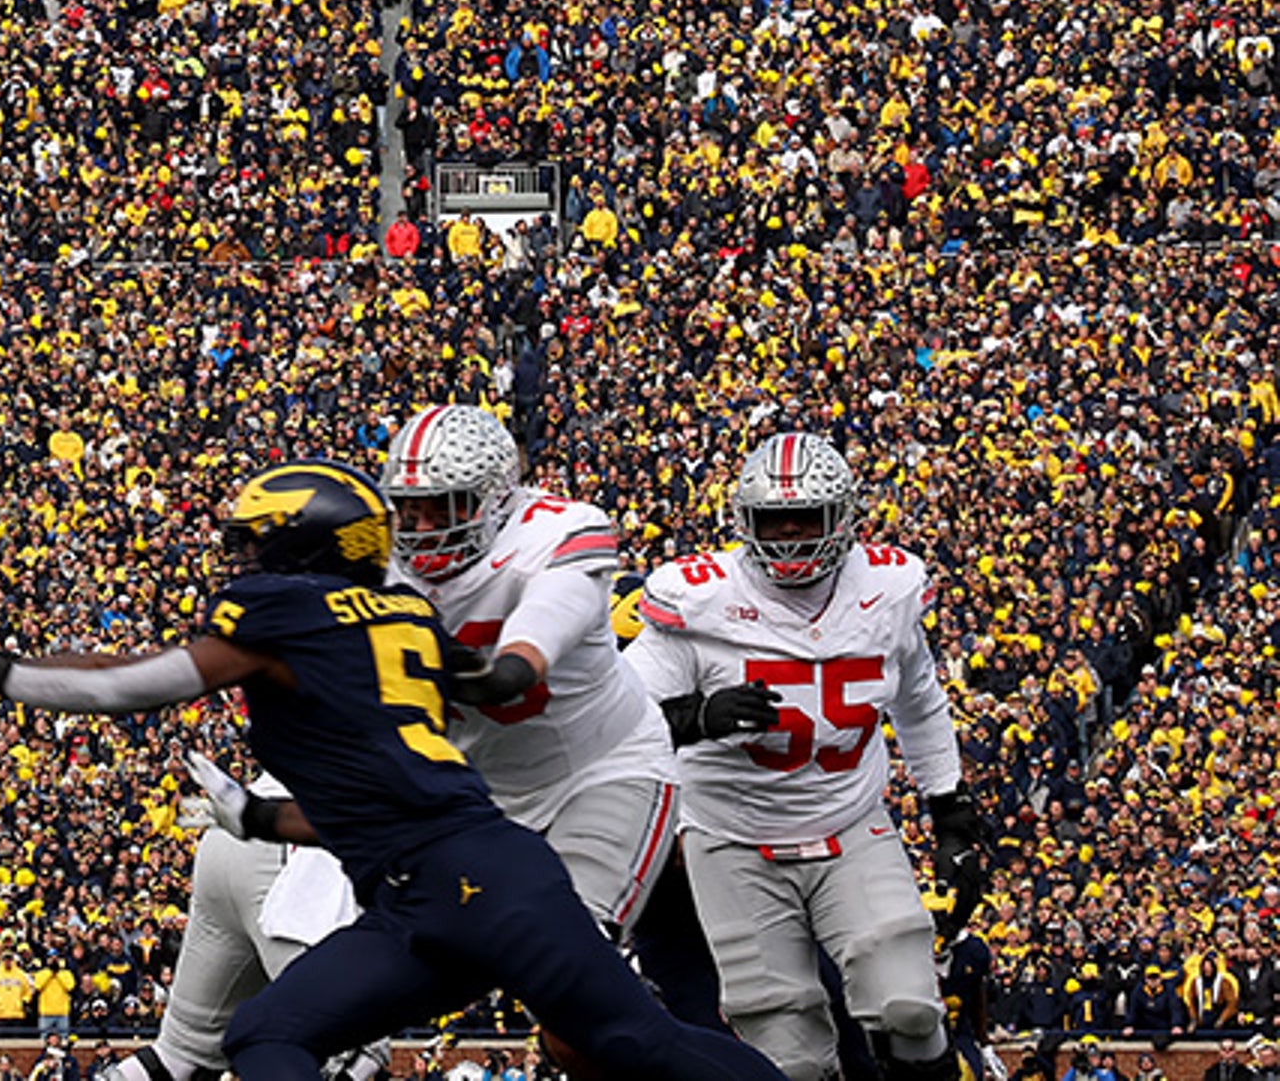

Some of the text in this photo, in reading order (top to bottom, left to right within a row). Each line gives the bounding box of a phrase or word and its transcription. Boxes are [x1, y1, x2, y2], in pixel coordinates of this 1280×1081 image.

[212, 601, 245, 635] 5
[366, 621, 469, 766] 5
[744, 655, 884, 773] 55
